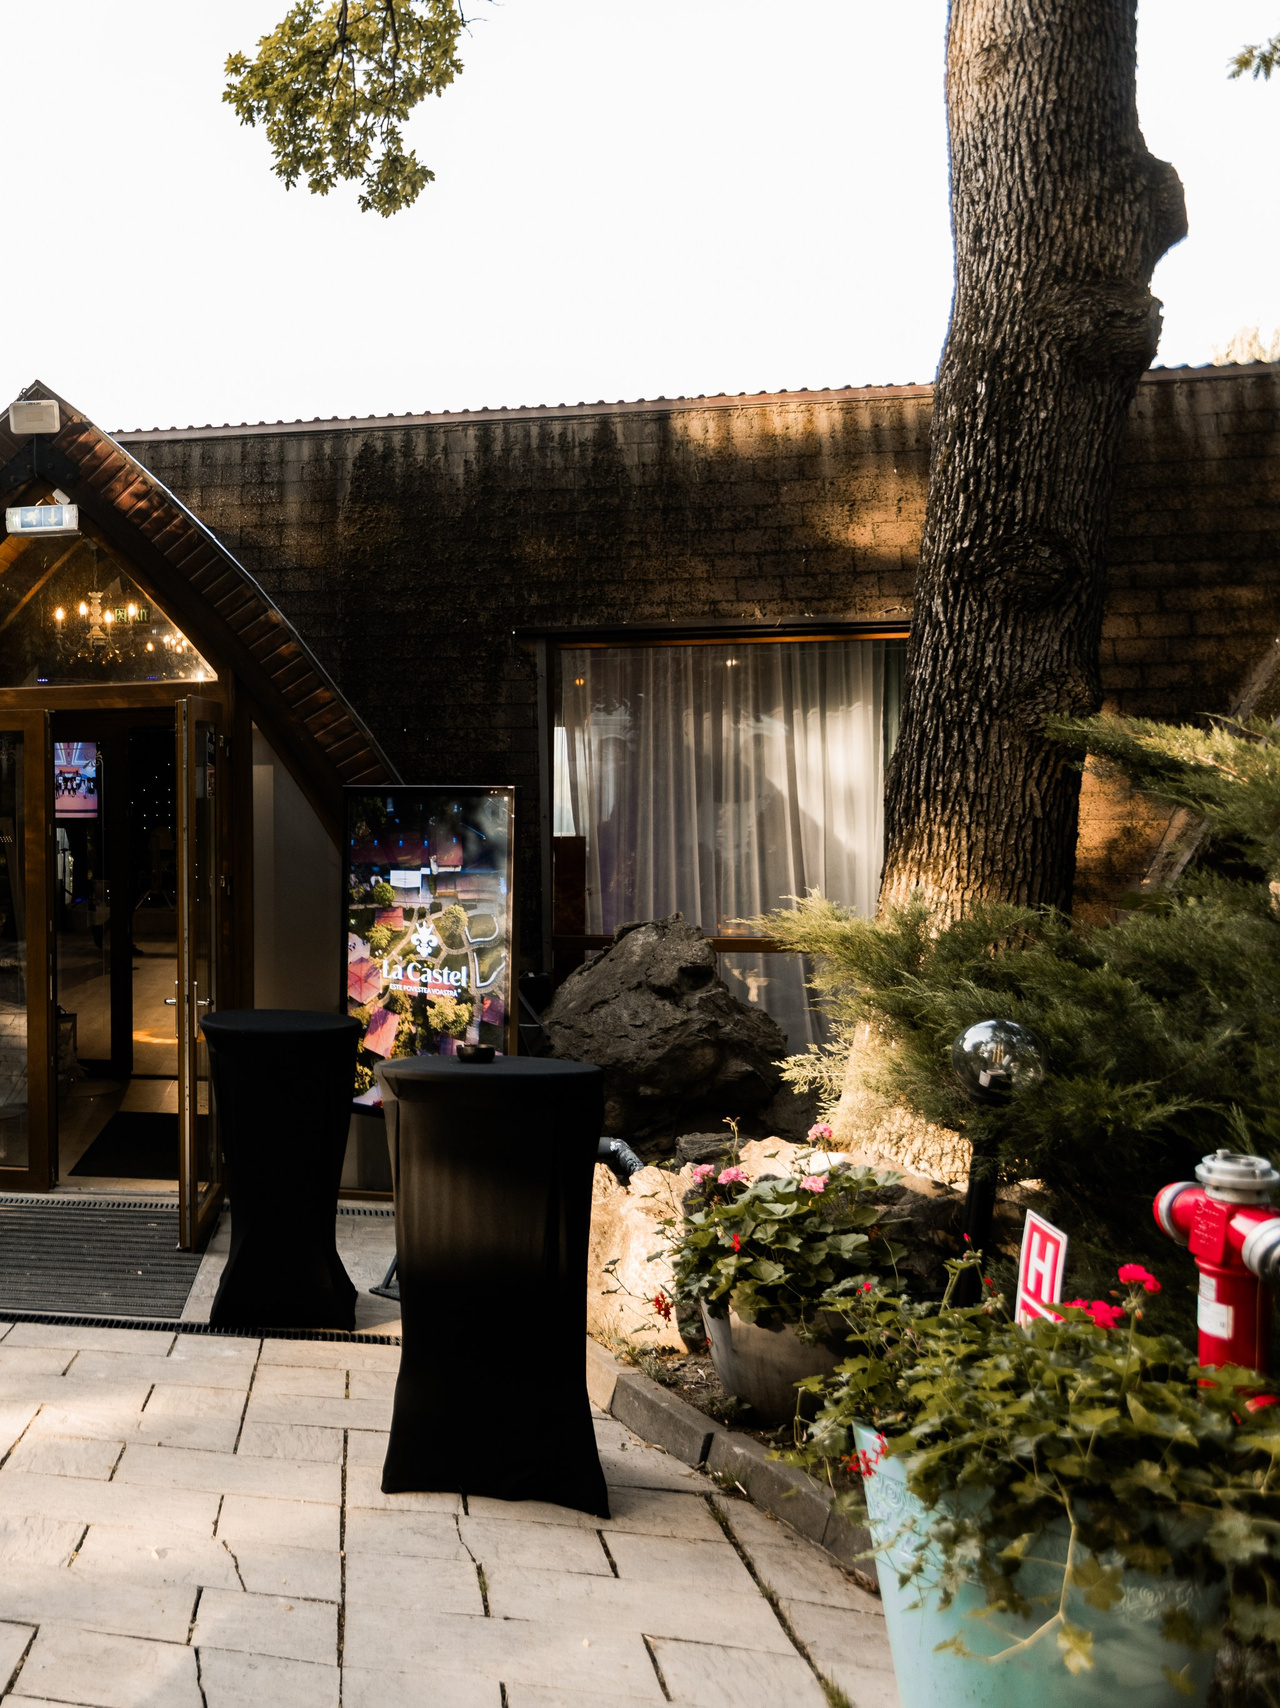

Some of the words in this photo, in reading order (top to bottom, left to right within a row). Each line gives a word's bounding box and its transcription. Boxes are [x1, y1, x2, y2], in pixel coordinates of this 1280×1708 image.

[128, 609, 148, 621] XIT
[382, 959, 404, 980] La
[407, 961, 468, 987] Castel
[1027, 1230, 1055, 1304] H
